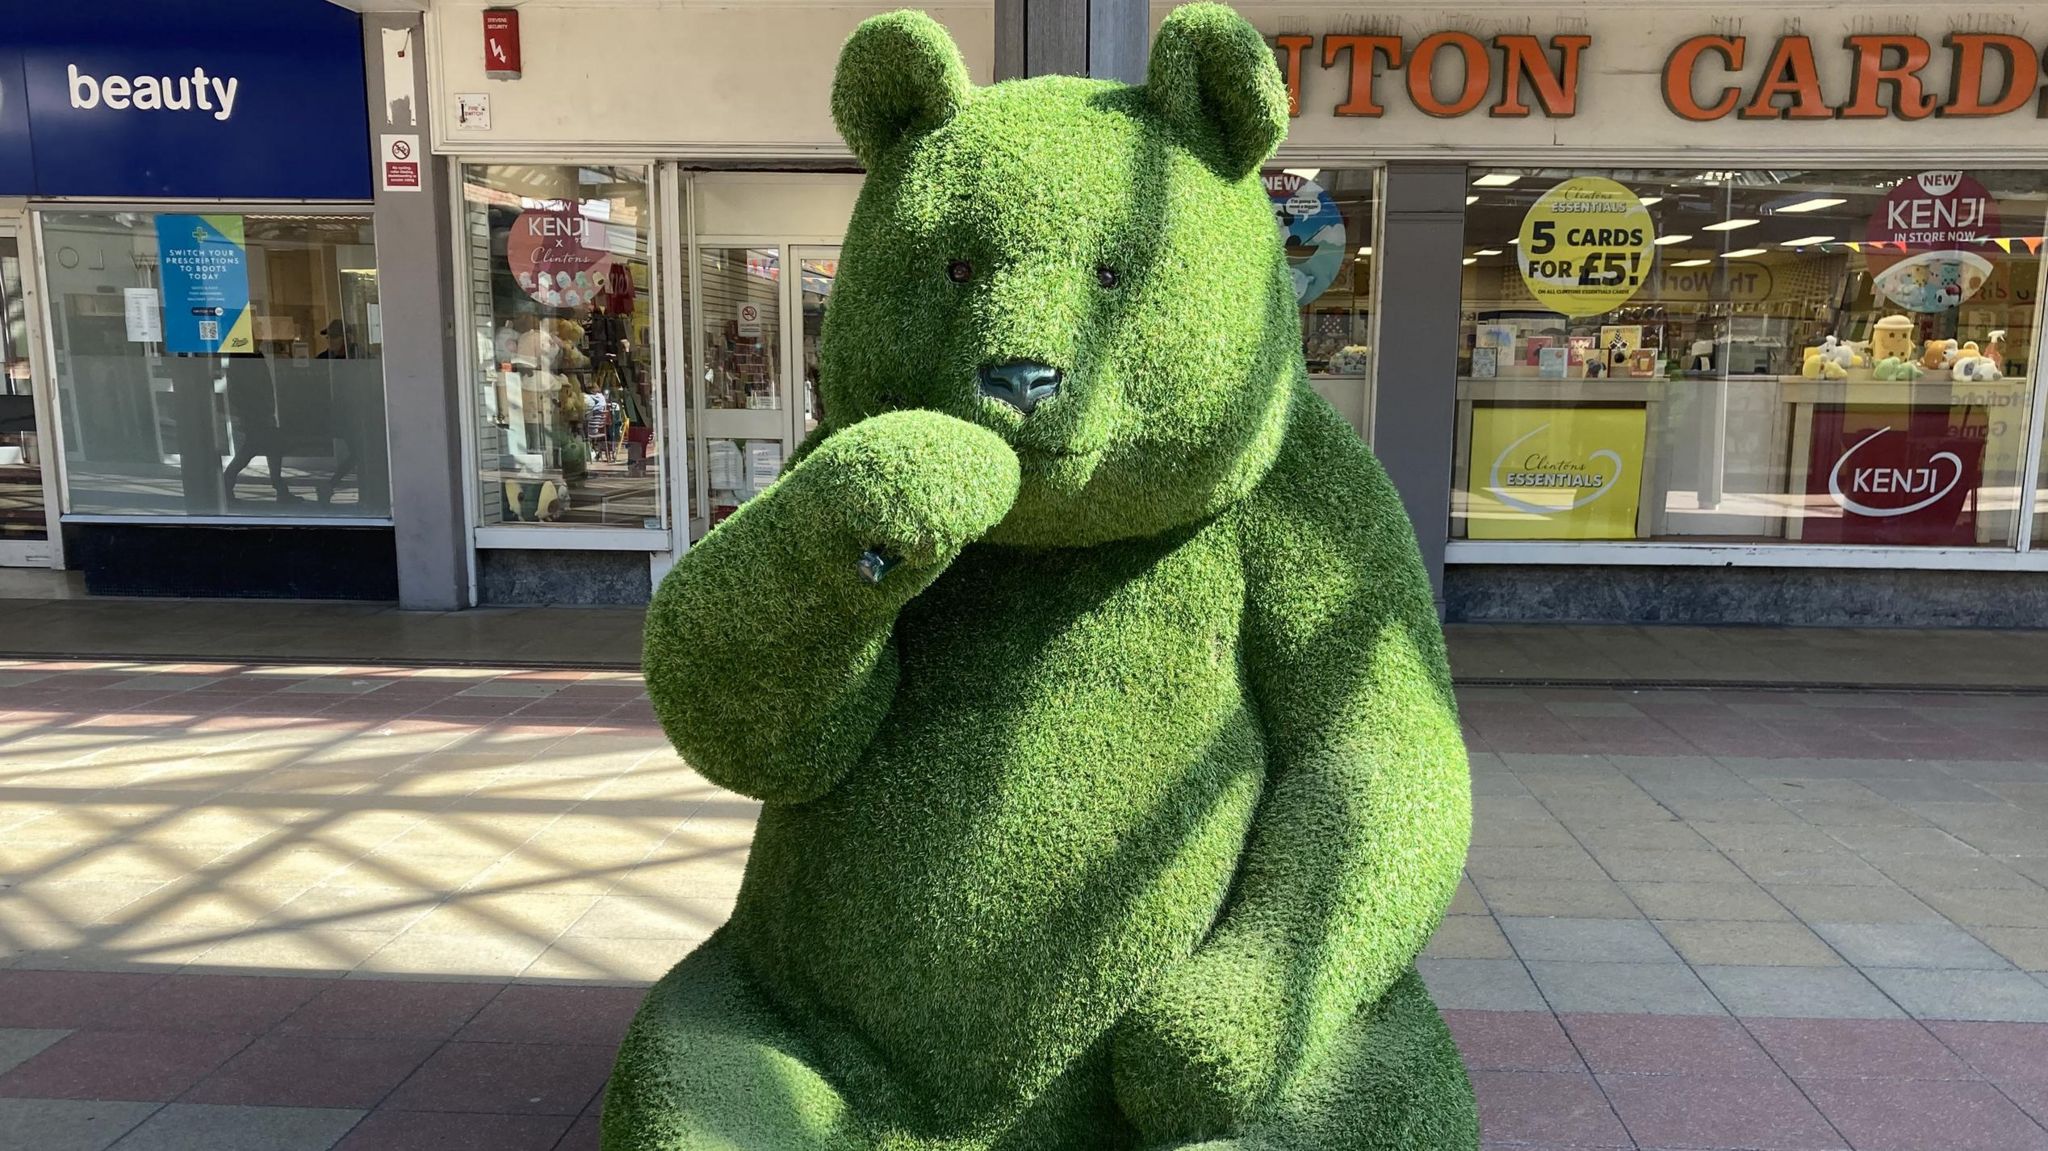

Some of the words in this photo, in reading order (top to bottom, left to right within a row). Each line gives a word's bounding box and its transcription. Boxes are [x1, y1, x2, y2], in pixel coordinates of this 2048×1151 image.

[1660, 33, 2048, 122] CARD
[67, 63, 238, 121] beauty
[1261, 176, 1300, 191] NEW
[1923, 174, 1957, 187] NEW
[1551, 201, 1628, 214] ESSENTIALS
[1887, 197, 1986, 230] KENJI
[528, 217, 590, 237] KENJI
[1530, 220, 1556, 255] 5
[1566, 228, 1643, 247] CARDS
[1894, 232, 1906, 243] IN
[1909, 231, 1945, 243] STORE
[1947, 231, 1976, 242] NOW
[166, 257, 240, 265] PRESCRIPTIONS
[530, 246, 592, 264] Clintons
[195, 265, 227, 273] BOOTS
[1528, 260, 1573, 279] FOR
[1577, 252, 1642, 287] £5!
[1523, 453, 1586, 471] Clintons
[1506, 473, 1603, 488] ESSENTIALS
[1852, 467, 1938, 494] KENJI
